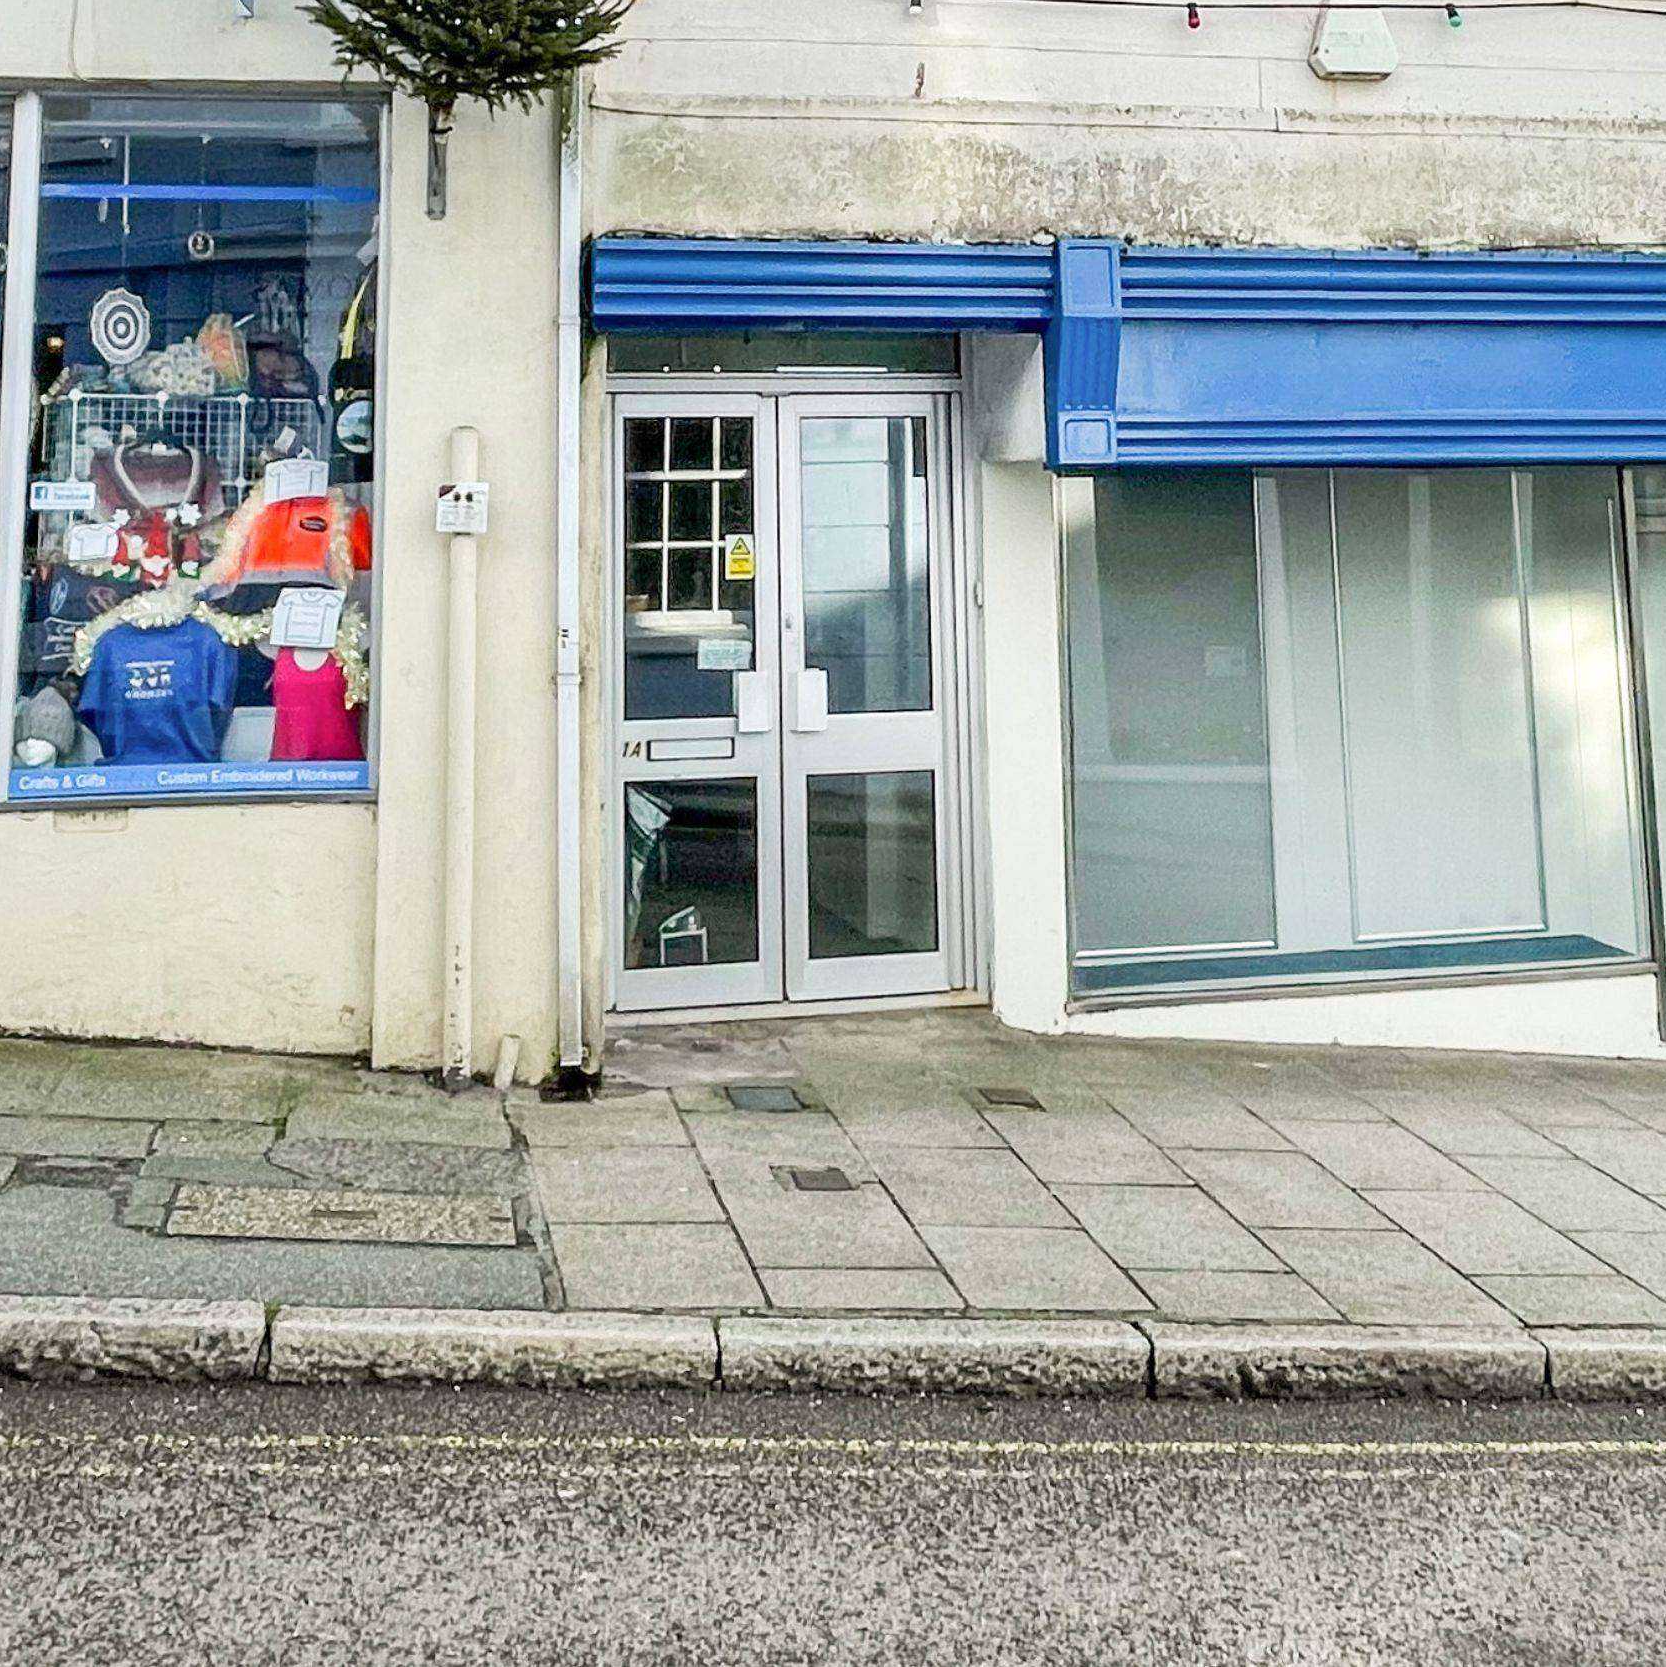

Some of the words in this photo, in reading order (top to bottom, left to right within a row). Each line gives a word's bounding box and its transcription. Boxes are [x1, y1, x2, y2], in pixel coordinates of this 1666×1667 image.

[19, 774, 59, 790] Crafts
[61, 773, 73, 789] &
[156, 769, 208, 785] Custom
[211, 768, 293, 784] Embroidered
[295, 767, 359, 782] Workwear
